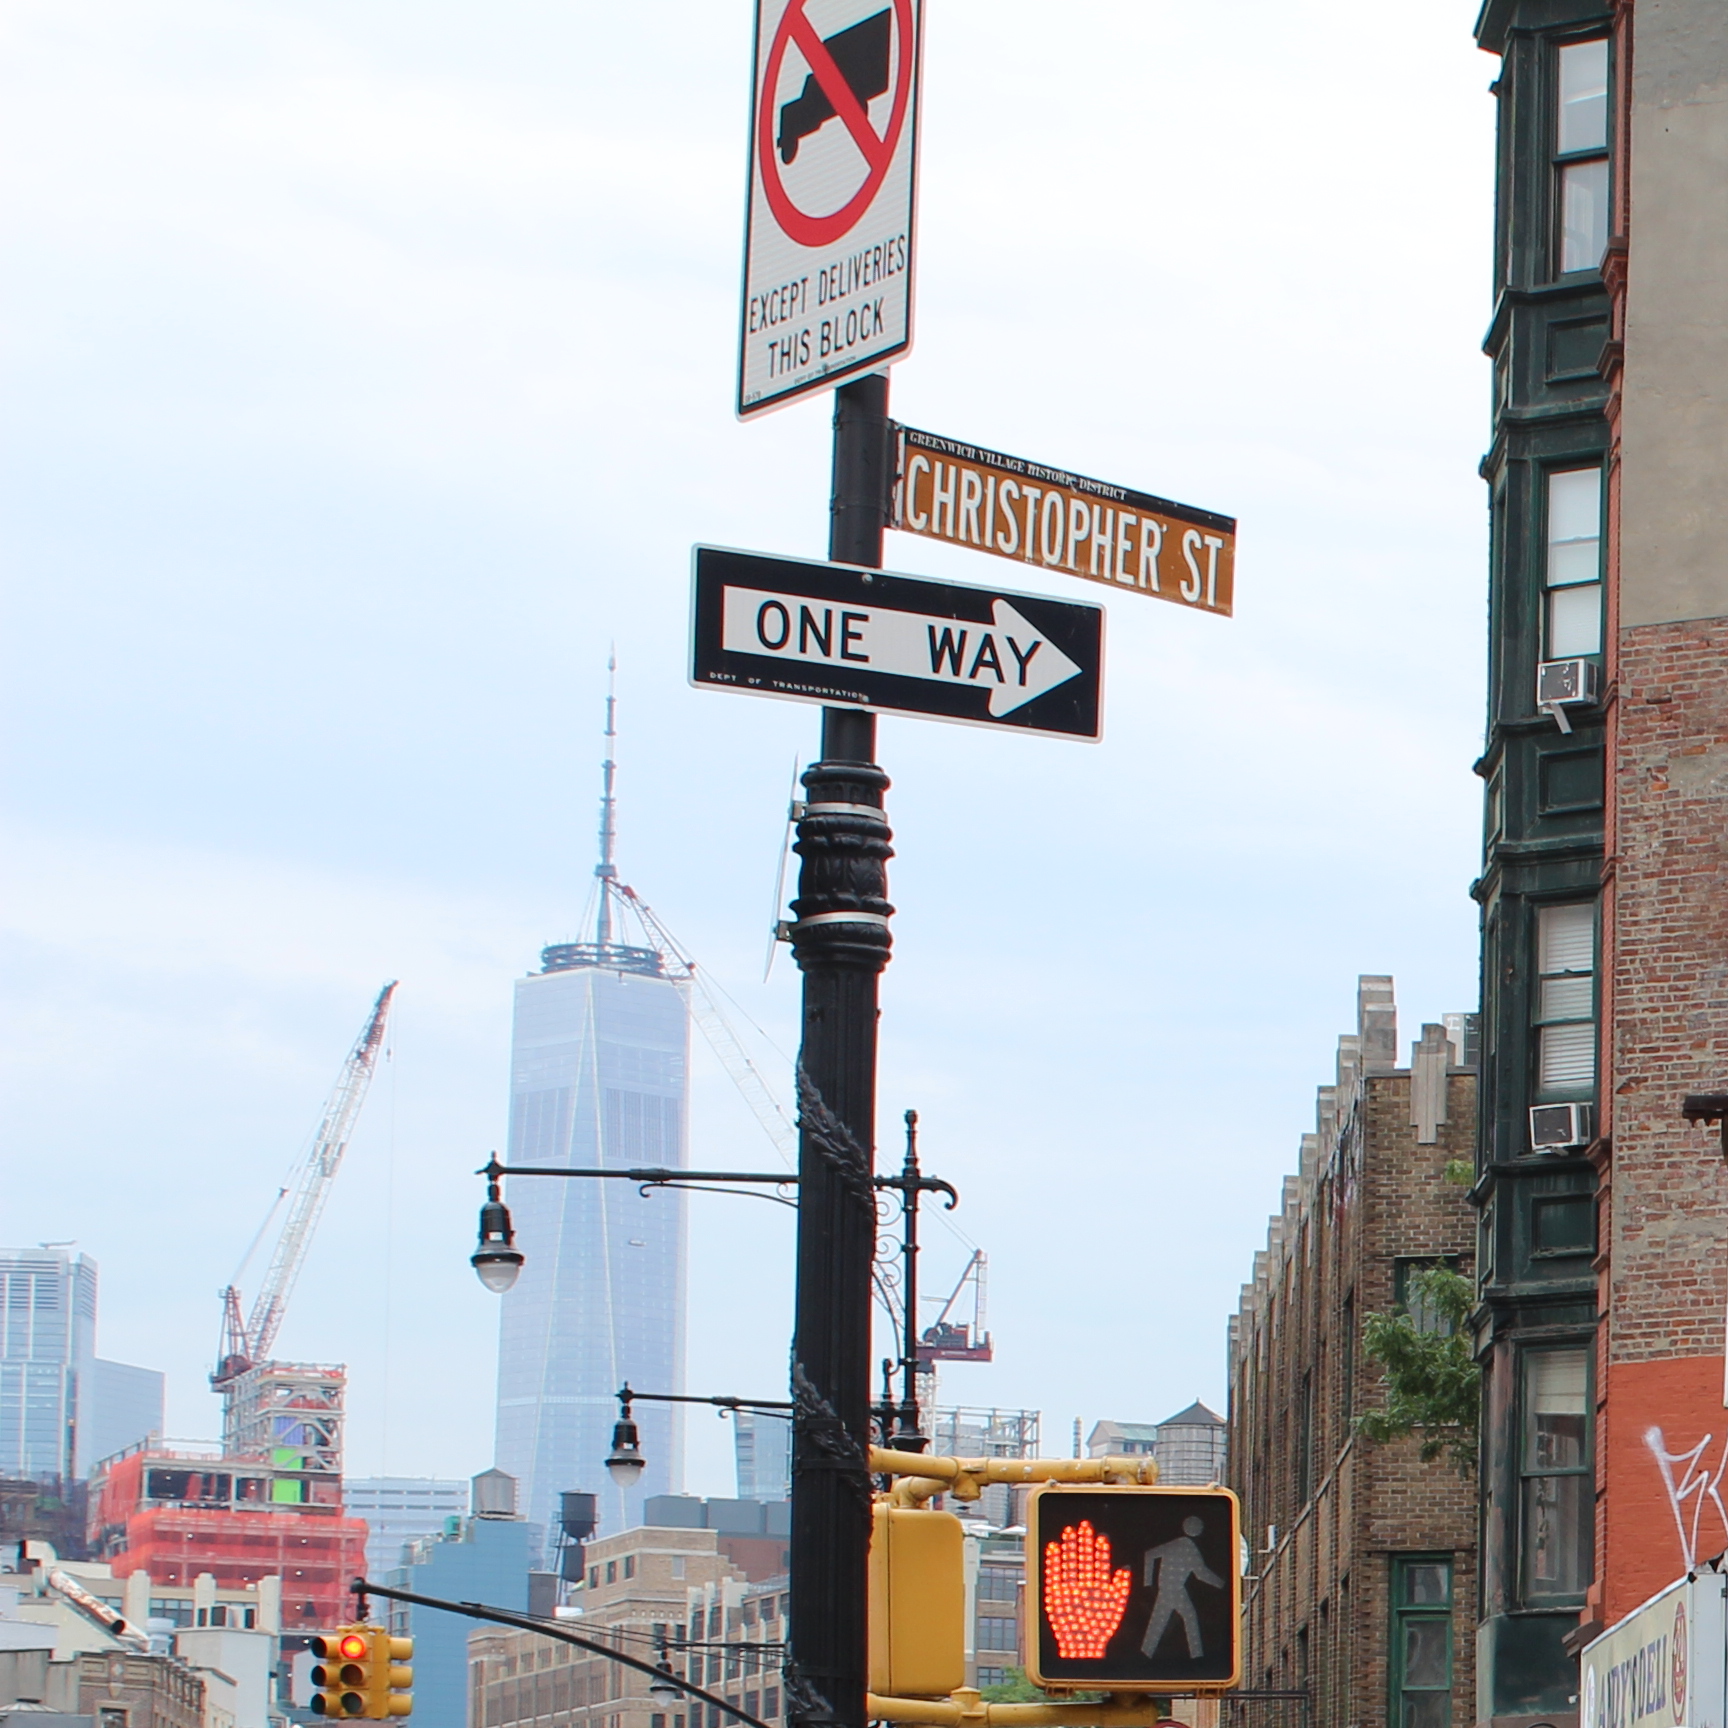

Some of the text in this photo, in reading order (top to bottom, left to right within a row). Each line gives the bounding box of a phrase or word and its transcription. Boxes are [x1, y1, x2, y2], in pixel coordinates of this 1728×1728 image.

[750, 234, 905, 333] EXCEPT DELIVERIES
[768, 297, 885, 378] THIS BLOCK
[909, 432, 1127, 501] GREENWICH VILLAGE DISTRICT
[906, 454, 1224, 608] CHRISTOPHER ST
[709, 671, 762, 686] DEPT OF
[757, 600, 1042, 688] ONE WAY
[1638, 1634, 1669, 1719] DELI
